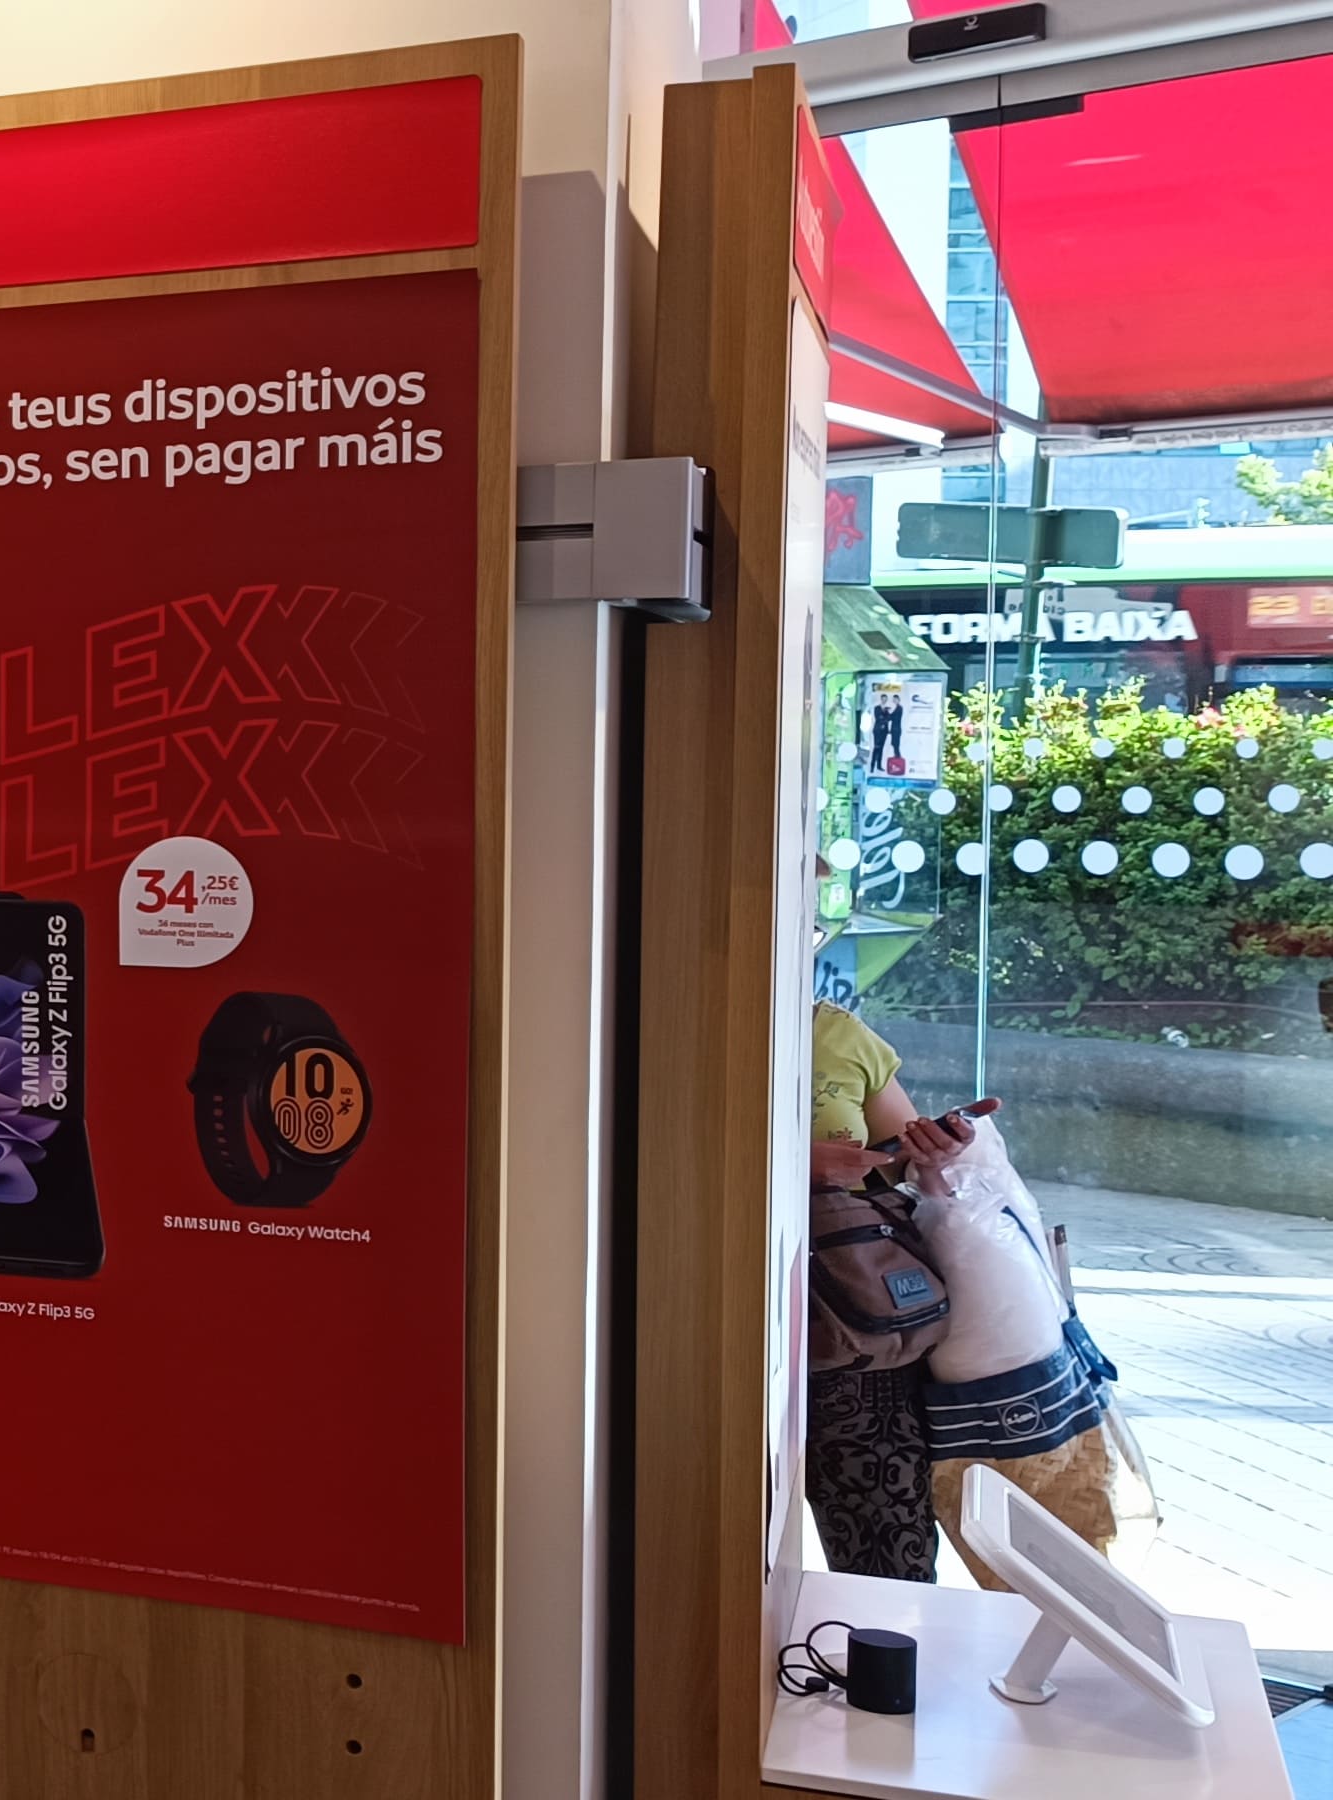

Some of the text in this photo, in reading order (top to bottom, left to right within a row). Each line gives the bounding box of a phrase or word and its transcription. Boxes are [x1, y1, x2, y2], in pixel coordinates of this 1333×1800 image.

[8, 391, 112, 431] teus
[124, 366, 426, 430] dispositivos
[65, 446, 150, 482] sen
[165, 436, 305, 488] pagar
[318, 417, 444, 469] máis
[1063, 610, 1198, 642] BAIXA
[136, 869, 198, 914] 34
[201, 892, 237, 906] /mes
[138, 928, 177, 937] Vodafone
[170, 920, 197, 929] meses
[176, 939, 195, 947] Plus
[47, 915, 74, 1111] Galaxy Z Flip3 5G
[21, 990, 40, 1108] SAMSUNG
[163, 1215, 371, 1243] SAMSUNG Galaxy Watch4
[27, 1302, 36, 1315] Z
[38, 1303, 71, 1320] Flip3
[74, 1306, 95, 1320] 5G
